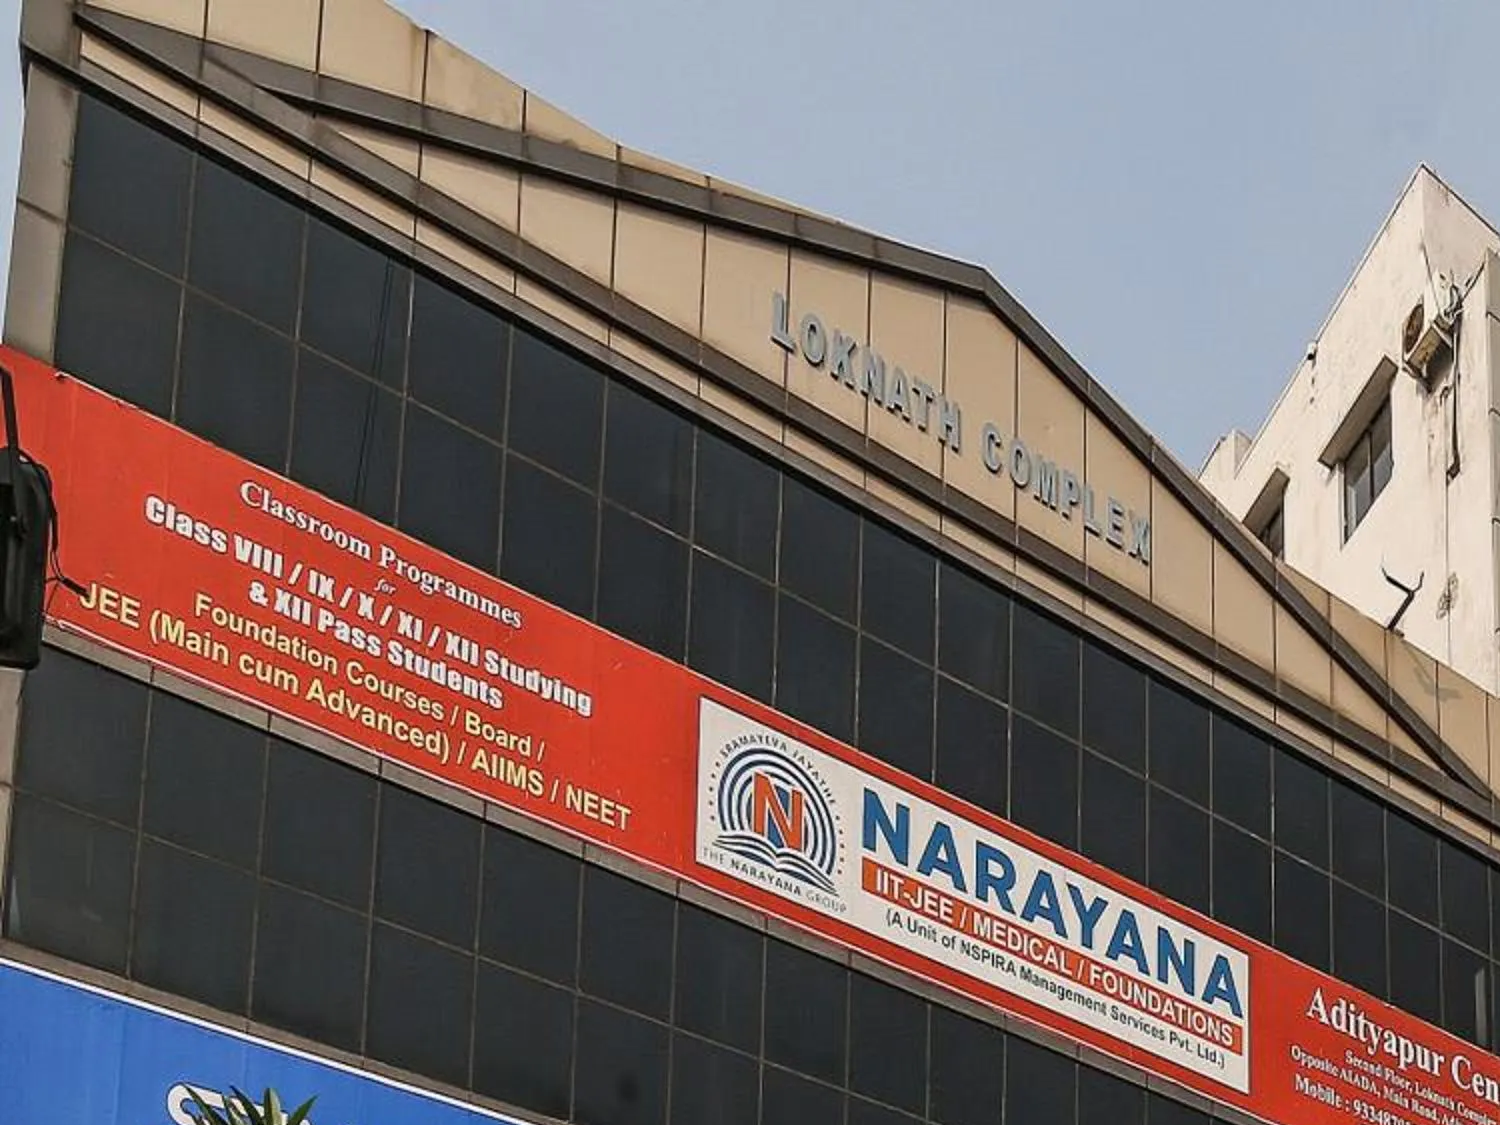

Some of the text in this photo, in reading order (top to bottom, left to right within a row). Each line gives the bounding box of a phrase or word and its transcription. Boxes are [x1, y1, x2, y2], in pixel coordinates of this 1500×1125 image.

[770, 291, 1152, 566] LOKNATH COMPLEX
[145, 495, 227, 553] Class
[234, 533, 283, 580] VIII
[308, 567, 335, 600] IX
[356, 593, 378, 620] X
[398, 610, 425, 643] XI
[444, 631, 480, 665] XII
[484, 653, 593, 718] Studying
[239, 479, 523, 630] Classroom Programmes
[375, 574, 397, 595] for
[79, 582, 141, 629] JEE
[149, 609, 230, 667] (Main
[239, 652, 300, 696] cum
[306, 670, 452, 766] Advanced)
[471, 752, 545, 798] AIIMS
[565, 787, 631, 833] NEET
[195, 595, 338, 676] Foundation
[346, 661, 444, 722] Courses
[465, 713, 532, 757] Board
[249, 580, 503, 709] & XII Pass Students
[730, 858, 802, 896] NARAYANA
[862, 786, 1244, 1019] NARAYANA
[874, 864, 955, 925] IIT-JEE
[973, 914, 1073, 978] MEDICAL
[1089, 964, 1235, 1047] FOUNDATIONS
[884, 906, 904, 930] (A
[907, 913, 938, 945] Unit
[941, 929, 958, 954] of
[960, 934, 1017, 977] NSPIRA
[1019, 962, 1108, 1018] Management
[1110, 999, 1166, 1042] Services
[1169, 1026, 1195, 1055] Pvt.
[1294, 1073, 1343, 1109] Mobile
[1305, 986, 1445, 1078] Adityapur
